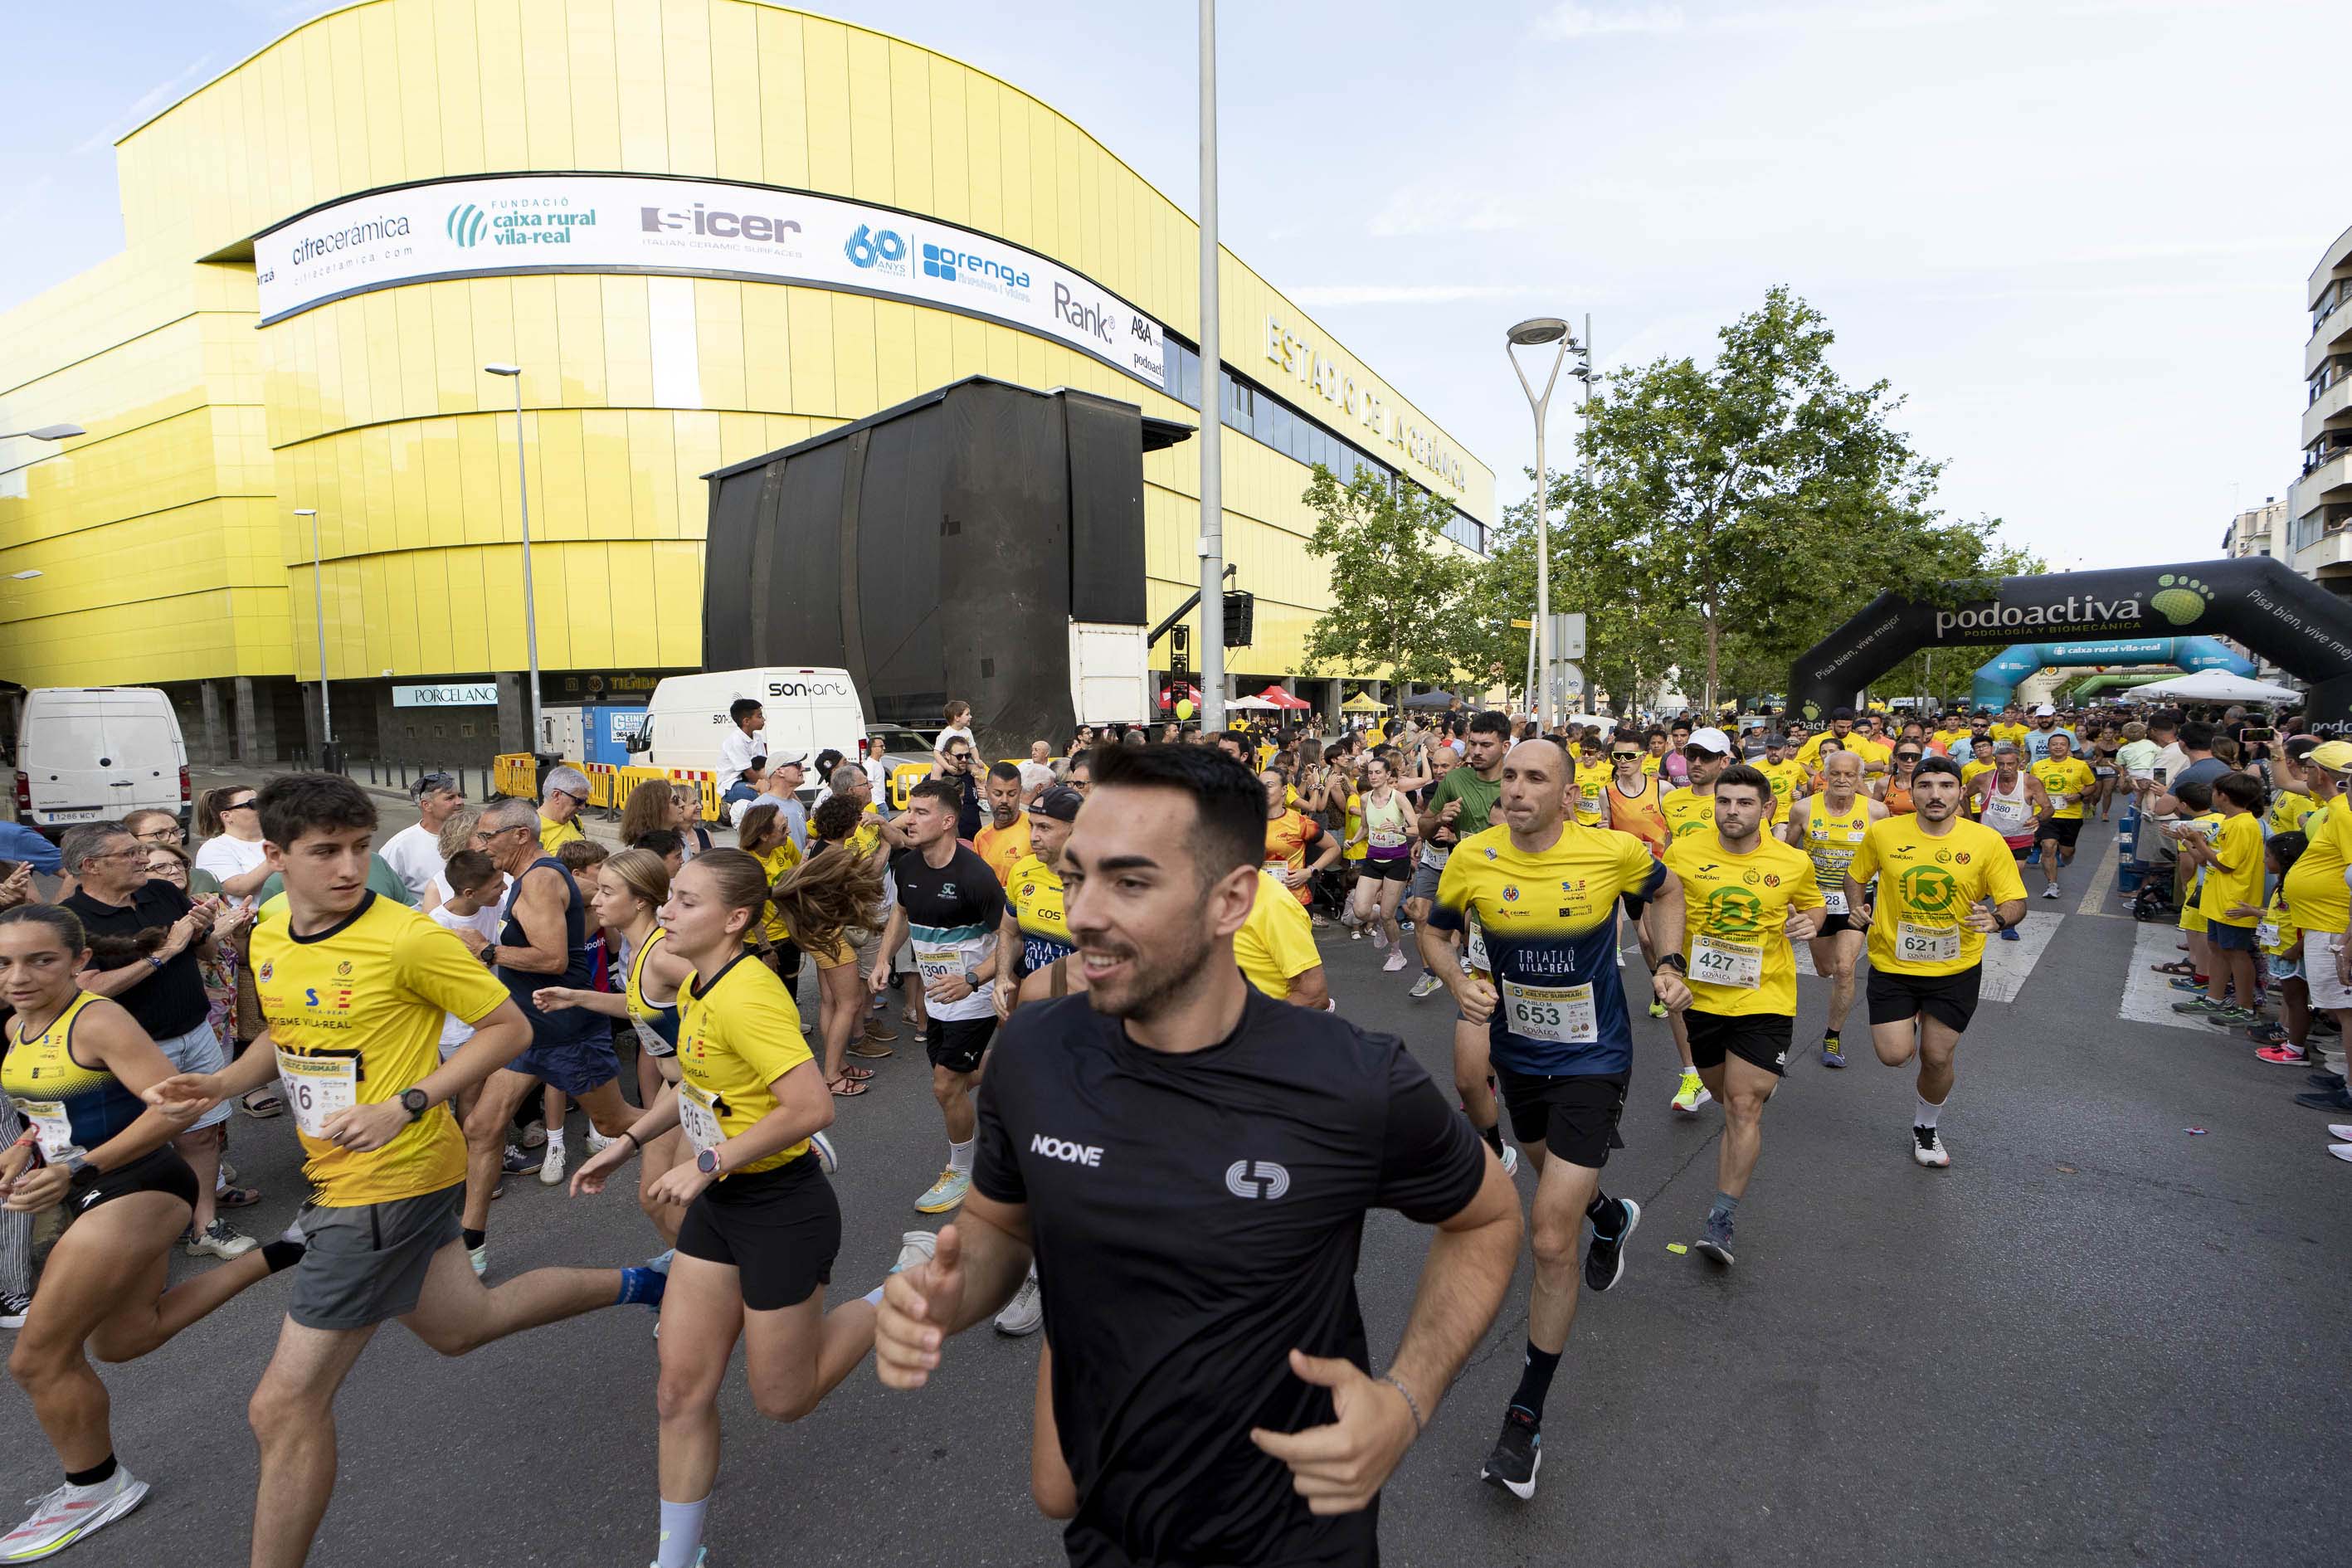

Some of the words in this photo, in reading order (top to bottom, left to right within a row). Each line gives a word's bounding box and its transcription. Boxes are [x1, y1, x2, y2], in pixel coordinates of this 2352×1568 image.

[491, 197, 569, 209] FUNDACIÓ
[493, 211, 542, 227] caixa
[548, 209, 597, 226] rural
[293, 215, 411, 265] cifrecerámica
[494, 227, 571, 246] vila-real
[641, 238, 685, 247] ITALIAN
[689, 241, 740, 251] CERAMIC
[744, 245, 802, 259] SURFACES
[877, 261, 906, 274] ANYS
[1131, 315, 1152, 346] A&A
[1264, 313, 1356, 415] ESTADIO
[1360, 387, 1381, 435] DE
[1383, 406, 1405, 450] LA
[1406, 425, 1466, 493] CERÁMICA
[1936, 595, 2142, 639] podoactiva
[2247, 589, 2274, 611] Pisa
[2273, 606, 2301, 630] bien,
[2304, 625, 2330, 644] vive
[1964, 627, 2033, 637] PODOLOGÍA
[2049, 621, 2142, 634] BIOMECÁNICA
[1814, 663, 1836, 680] Pisa
[1833, 648, 1858, 666] bien,
[1856, 635, 1875, 651] vive
[1873, 614, 1901, 638] mejor
[2067, 646, 2092, 655] caixa
[2120, 643, 2161, 652] vila-real
[415, 687, 498, 703] PORCELANO
[1990, 802, 2011, 814] 1380
[1371, 833, 1386, 842] 744
[1905, 937, 1936, 952] 621
[1518, 946, 1575, 964] TRIATLÓ
[1699, 952, 1735, 971] 427
[1519, 962, 1575, 974] VILA-REAL
[1522, 999, 1545, 1007] PABLO
[1516, 1003, 1561, 1026] 653
[1522, 1025, 1560, 1037] COVALCA
[683, 1104, 702, 1137] 315
[1030, 1133, 1105, 1168] NOONE
